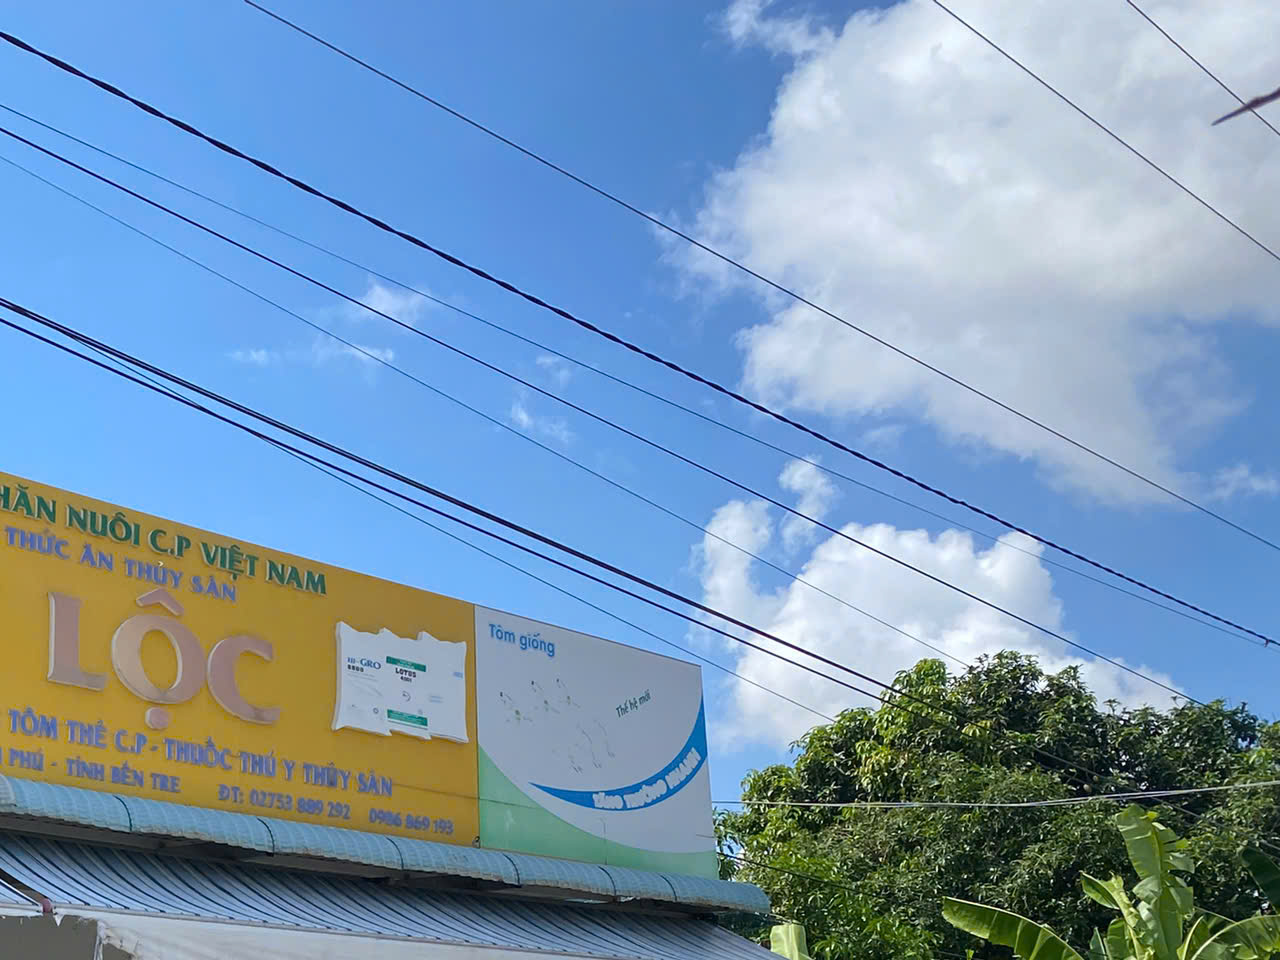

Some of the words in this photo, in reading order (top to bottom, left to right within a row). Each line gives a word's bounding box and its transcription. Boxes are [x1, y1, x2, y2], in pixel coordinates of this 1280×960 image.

[4, 524, 71, 560] THỨC
[80, 543, 113, 572] ĂN
[124, 557, 184, 592] THỦY
[191, 573, 238, 603] SẢN
[66, 505, 140, 547] NUÔI
[148, 529, 191, 559] C.P
[199, 543, 258, 582] VIỆT
[266, 559, 327, 595] NAM
[46, 587, 283, 731] LỘC
[488, 622, 517, 645] Tôm
[519, 631, 557, 659] giống
[8, 708, 58, 740] TÔM
[66, 719, 108, 749] THẺ
[114, 728, 148, 755] C.P
[163, 736, 233, 772] THUỐC
[239, 750, 277, 778] THÚ
[283, 759, 297, 782] Y
[110, 763, 145, 789] BẾN
[150, 771, 182, 794] TRE
